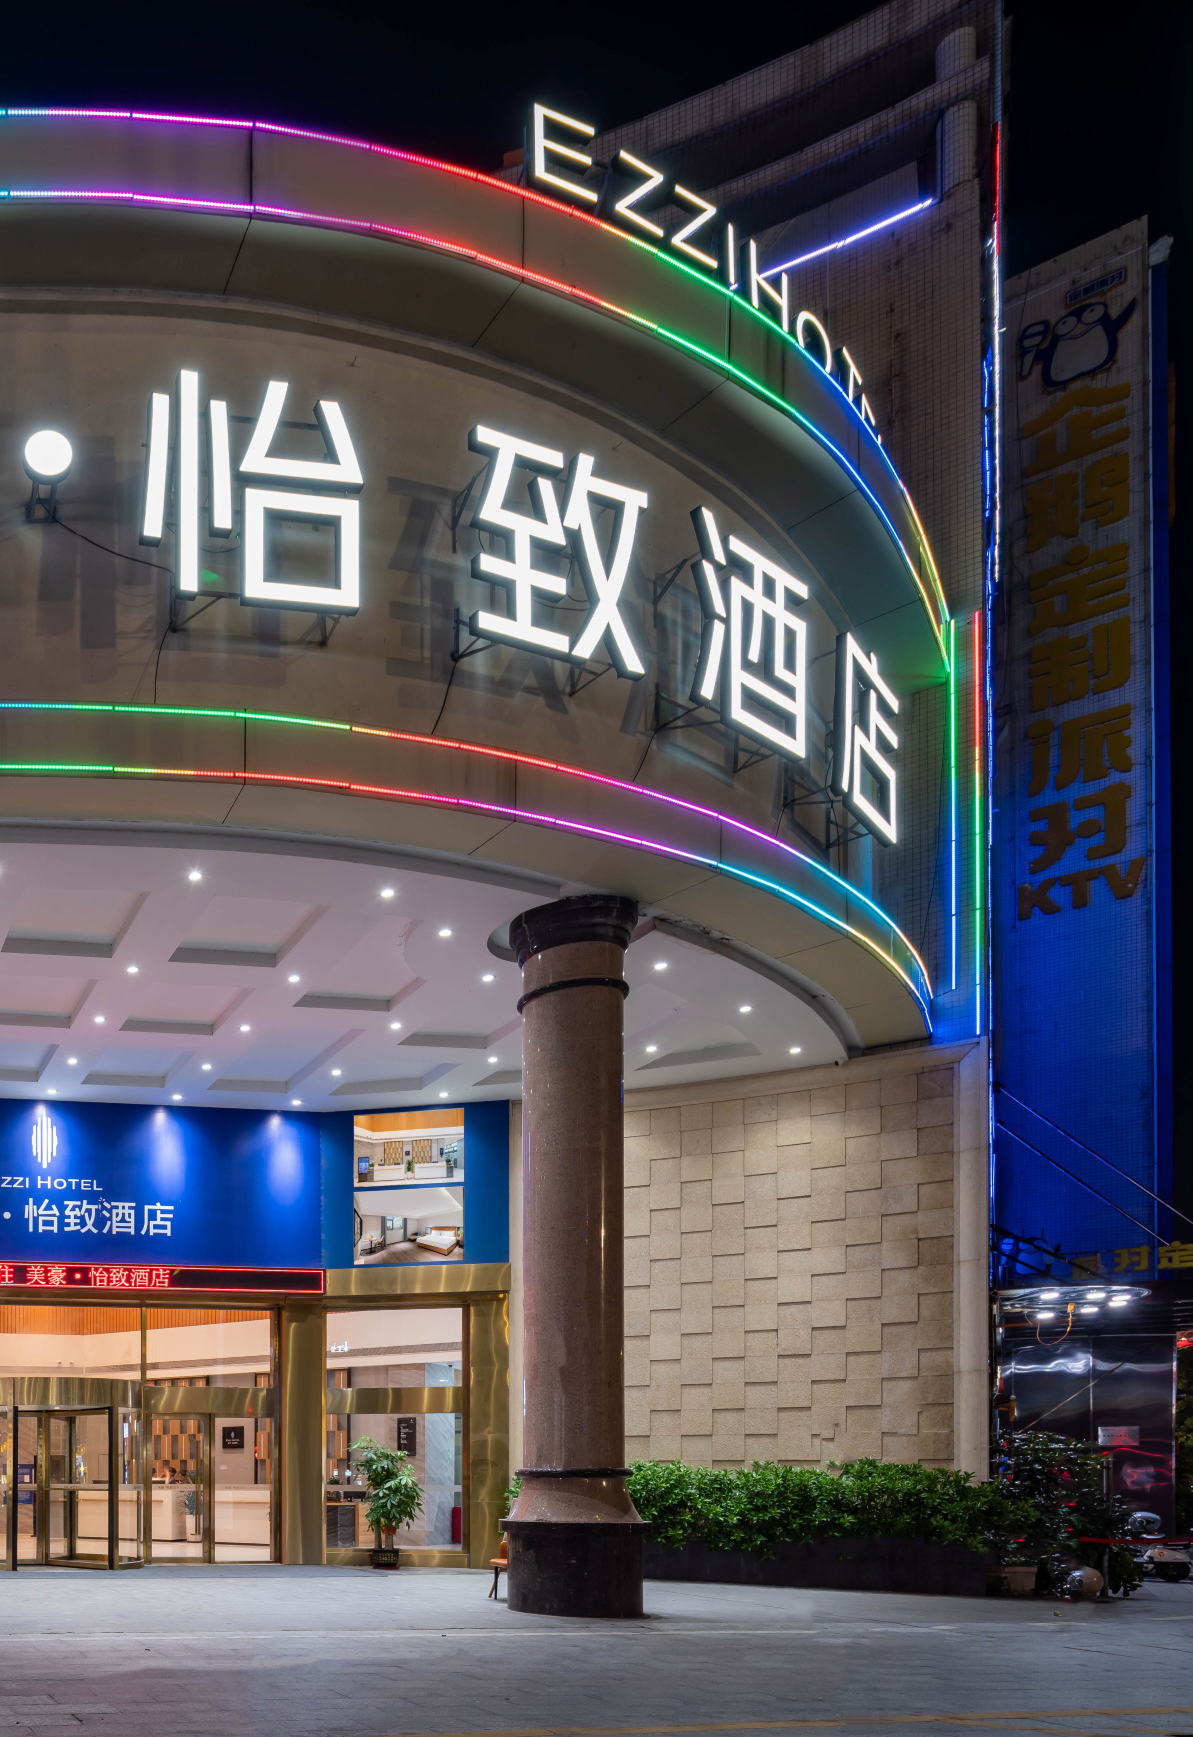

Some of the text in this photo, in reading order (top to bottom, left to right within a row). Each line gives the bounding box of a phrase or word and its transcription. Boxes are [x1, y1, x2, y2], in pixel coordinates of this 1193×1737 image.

[534, 102, 883, 444] EZZI HOT
[1022, 382, 1132, 875] 企鹅定制派对
[1017, 856, 1145, 921] KTV
[37, 1175, 103, 1191] HOTEL
[26, 1265, 170, 1288] 美豪·怡致酒店
